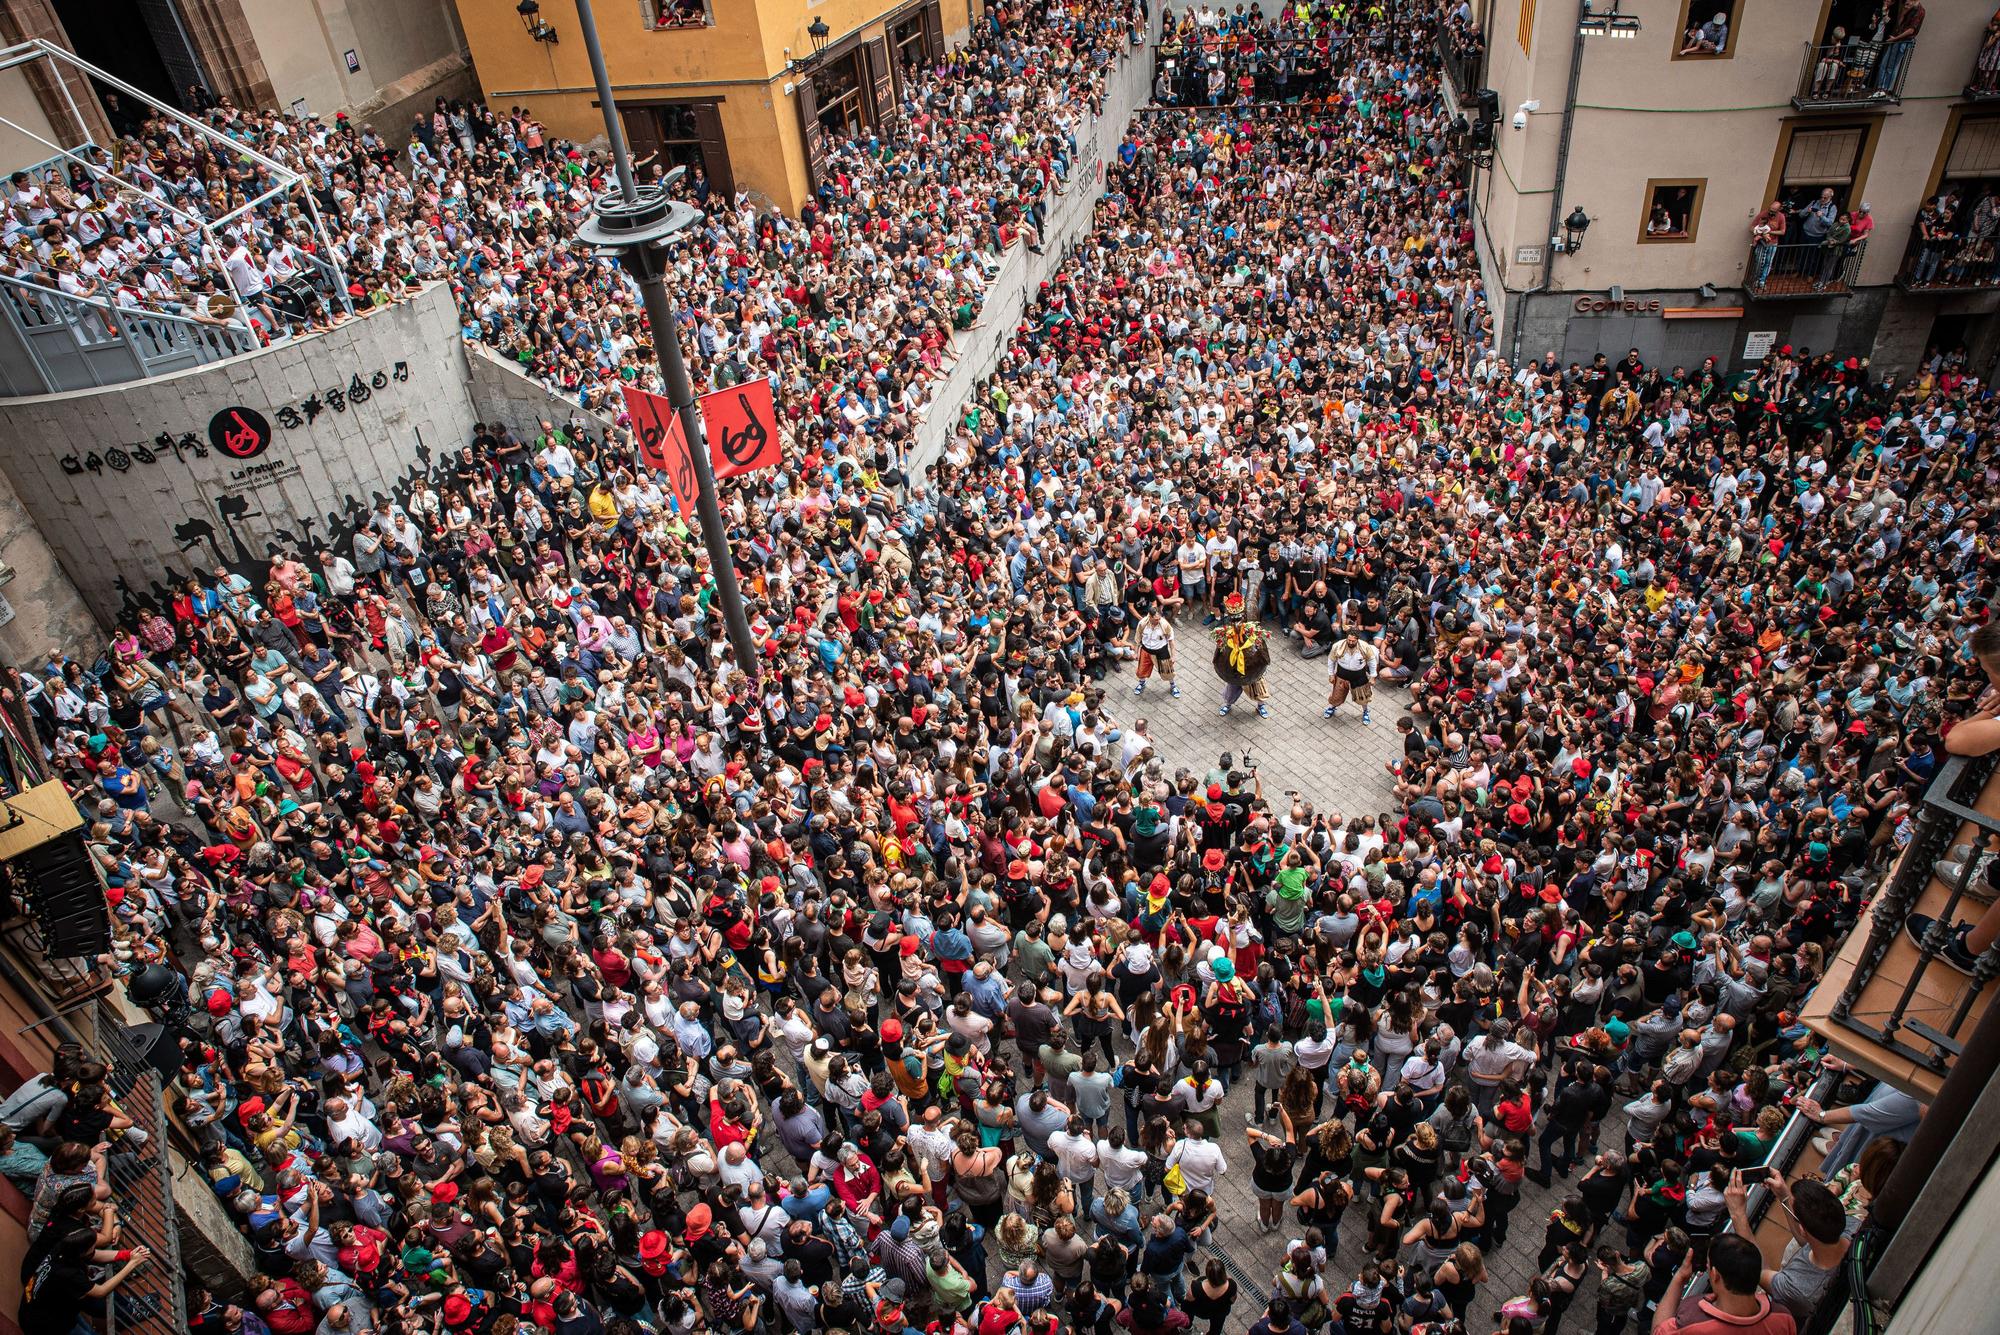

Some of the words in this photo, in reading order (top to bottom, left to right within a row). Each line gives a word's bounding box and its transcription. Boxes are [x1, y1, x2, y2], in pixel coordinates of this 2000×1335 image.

[230, 470, 246, 480] La
[246, 459, 285, 476] Patum
[254, 476, 262, 484] de
[269, 465, 301, 479] Humanitat
